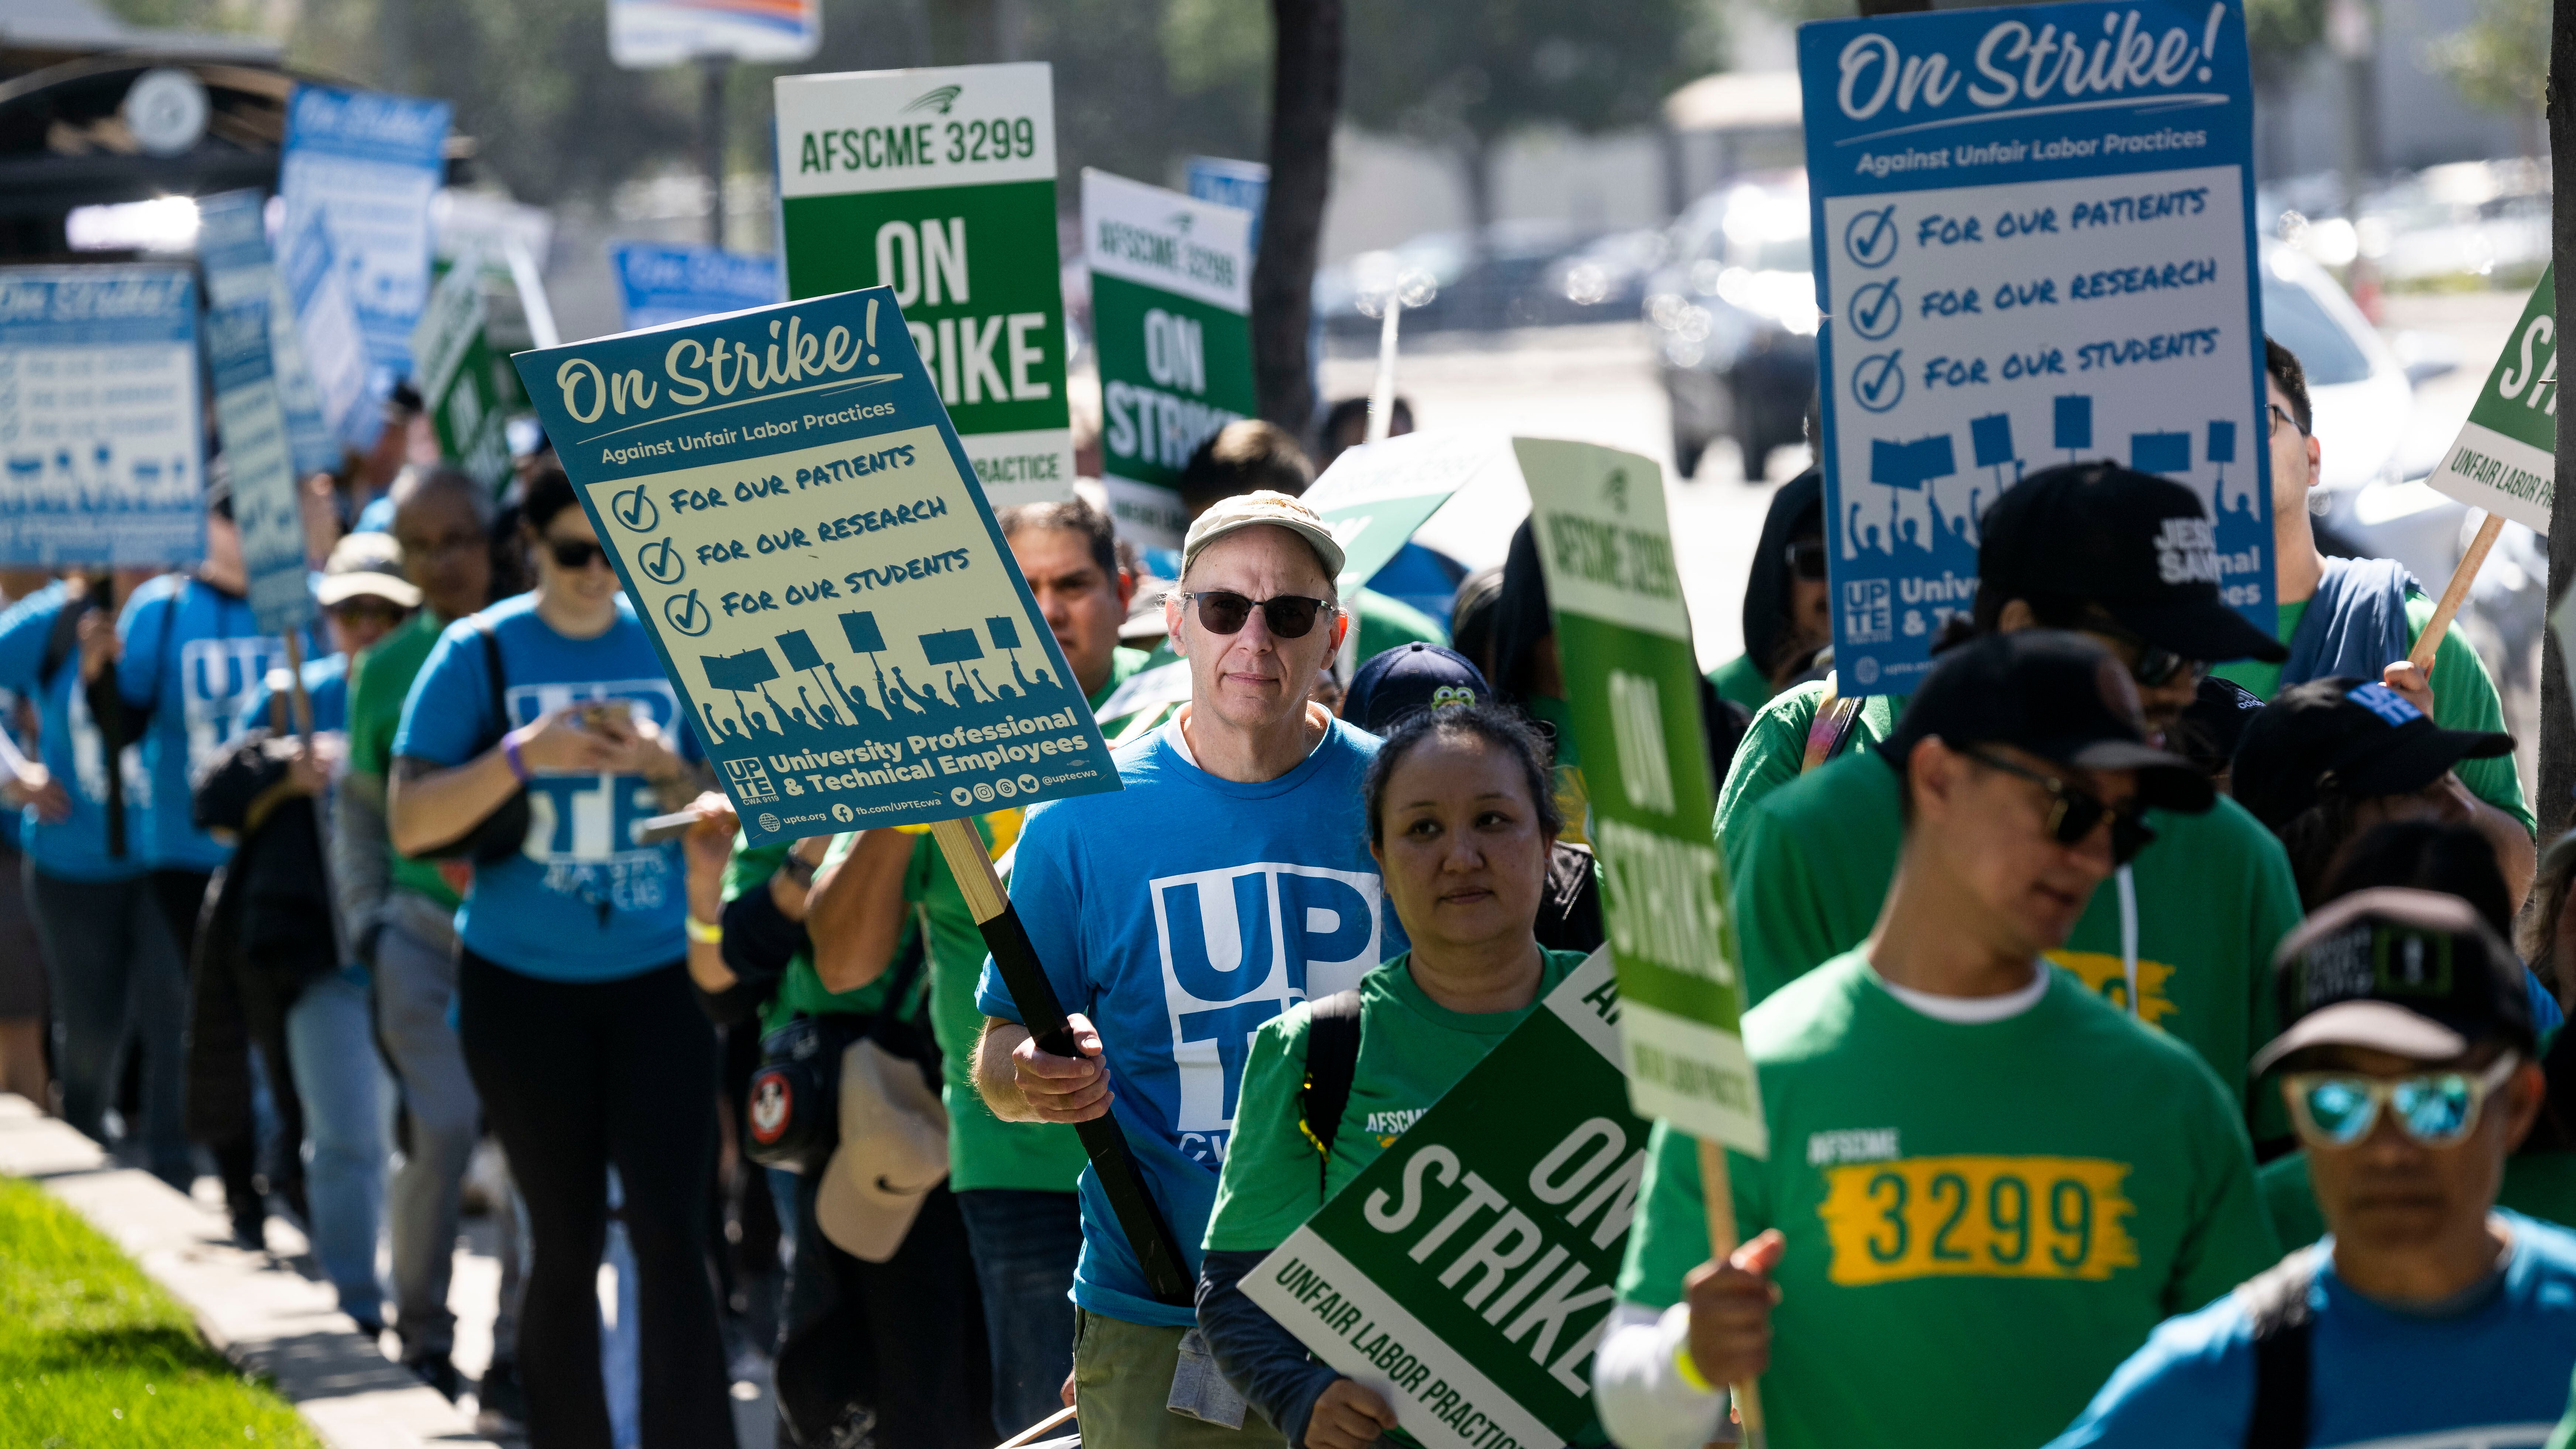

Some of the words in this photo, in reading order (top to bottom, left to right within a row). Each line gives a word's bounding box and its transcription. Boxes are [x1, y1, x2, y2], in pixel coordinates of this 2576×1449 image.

[1837, 33, 1961, 120] On
[1967, 3, 2226, 108] Strike!
[801, 123, 935, 174] AFSCME
[945, 116, 1035, 163] 3299
[1856, 148, 1950, 177] Against
[1957, 139, 2028, 167] Unfair
[2033, 133, 2099, 160] Labor
[2105, 127, 2207, 154] Practices
[1917, 214, 1983, 248] FOR
[1995, 206, 2059, 239] OUR
[2071, 187, 2209, 230] PATIENTS
[875, 216, 970, 309] ON
[1920, 287, 1982, 320] FOR
[1994, 278, 2058, 310] OUR
[2070, 257, 2217, 300] RESEARCH
[556, 358, 657, 423] On
[665, 298, 880, 405] Strike!
[905, 312, 1051, 406] RIKE
[1144, 307, 1206, 396] ON
[1923, 355, 1990, 389] FOR
[2002, 348, 2067, 380] OUR
[2077, 326, 2220, 371] STUDENTS
[601, 439, 675, 465] Against
[679, 427, 737, 451] Unfair
[741, 418, 798, 441] Labor
[803, 402, 895, 430] Practices
[973, 452, 1060, 483] RACTICE
[669, 487, 729, 515] FOR
[734, 475, 791, 503] OUR
[795, 444, 916, 490] PATIENTS
[2451, 445, 2502, 489] UNFAIR
[2496, 467, 2540, 502] LABOR
[696, 539, 752, 566] FOR
[756, 527, 812, 555] OUR
[817, 496, 948, 543] RESEARCH
[720, 591, 780, 617] FOR
[785, 578, 842, 605] OUR
[844, 547, 971, 594] STUDENTS
[725, 758, 761, 780] UP
[768, 739, 902, 773] University
[907, 706, 1078, 754] Professional
[783, 778, 805, 796] &
[805, 758, 936, 792] Technical
[937, 734, 1088, 771] Employees
[1608, 669, 1676, 816] ON
[733, 777, 774, 797] TE
[743, 797, 761, 806] CWA
[763, 795, 779, 804] 9119
[783, 812, 827, 825] upte.org
[855, 797, 941, 816] fb.com/UPTEcwa
[1042, 769, 1097, 786] @uptecwa
[1162, 871, 1373, 1002] UP
[1598, 815, 1736, 989] STRIKE
[1179, 997, 1305, 1123] T
[1528, 1116, 1649, 1251] ON
[1867, 1172, 2093, 1268] 3299
[1275, 1257, 1363, 1337] UNFAIR
[1349, 1321, 1431, 1394] LABOR
[1418, 1378, 1528, 1449] PRACTI
